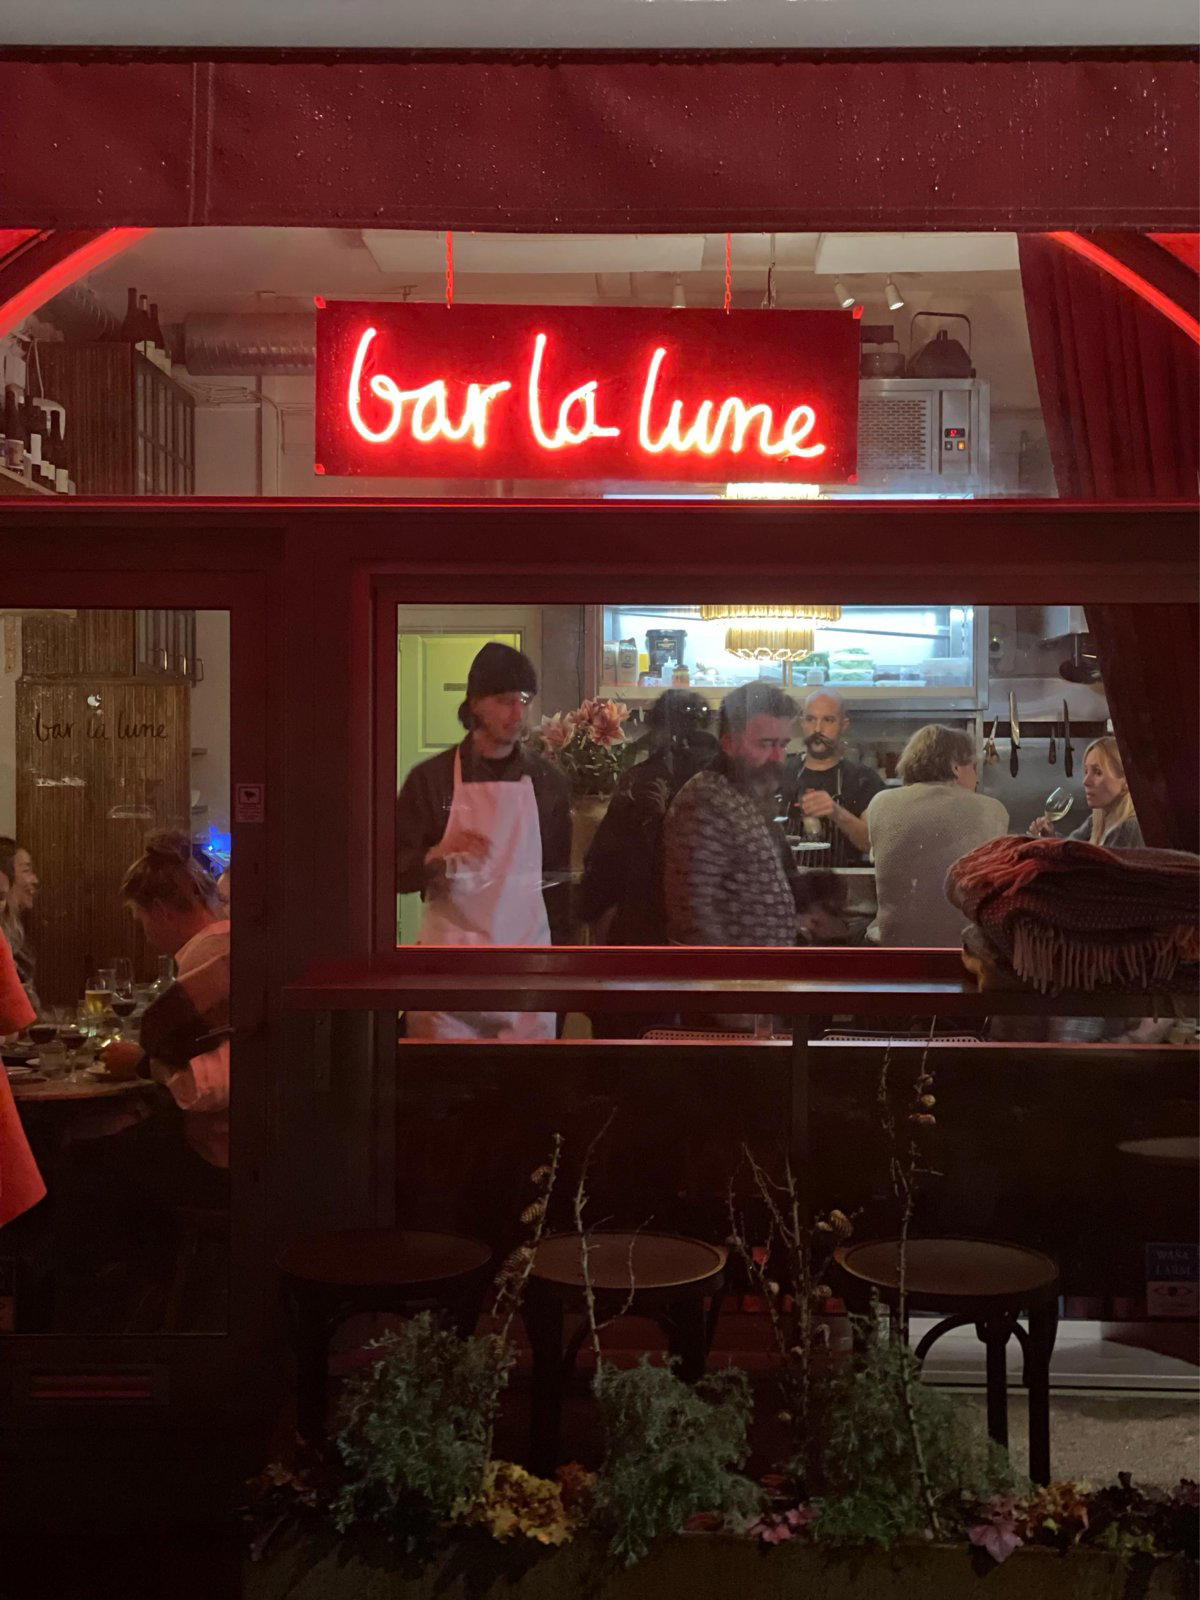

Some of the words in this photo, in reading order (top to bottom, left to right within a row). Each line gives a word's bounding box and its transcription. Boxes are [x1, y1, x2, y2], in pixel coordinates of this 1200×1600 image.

[347, 326, 513, 448] bar
[528, 332, 621, 450] la
[638, 346, 827, 459] lune
[35, 712, 75, 742] bar
[86, 716, 109, 740] la
[117, 710, 168, 740] lune
